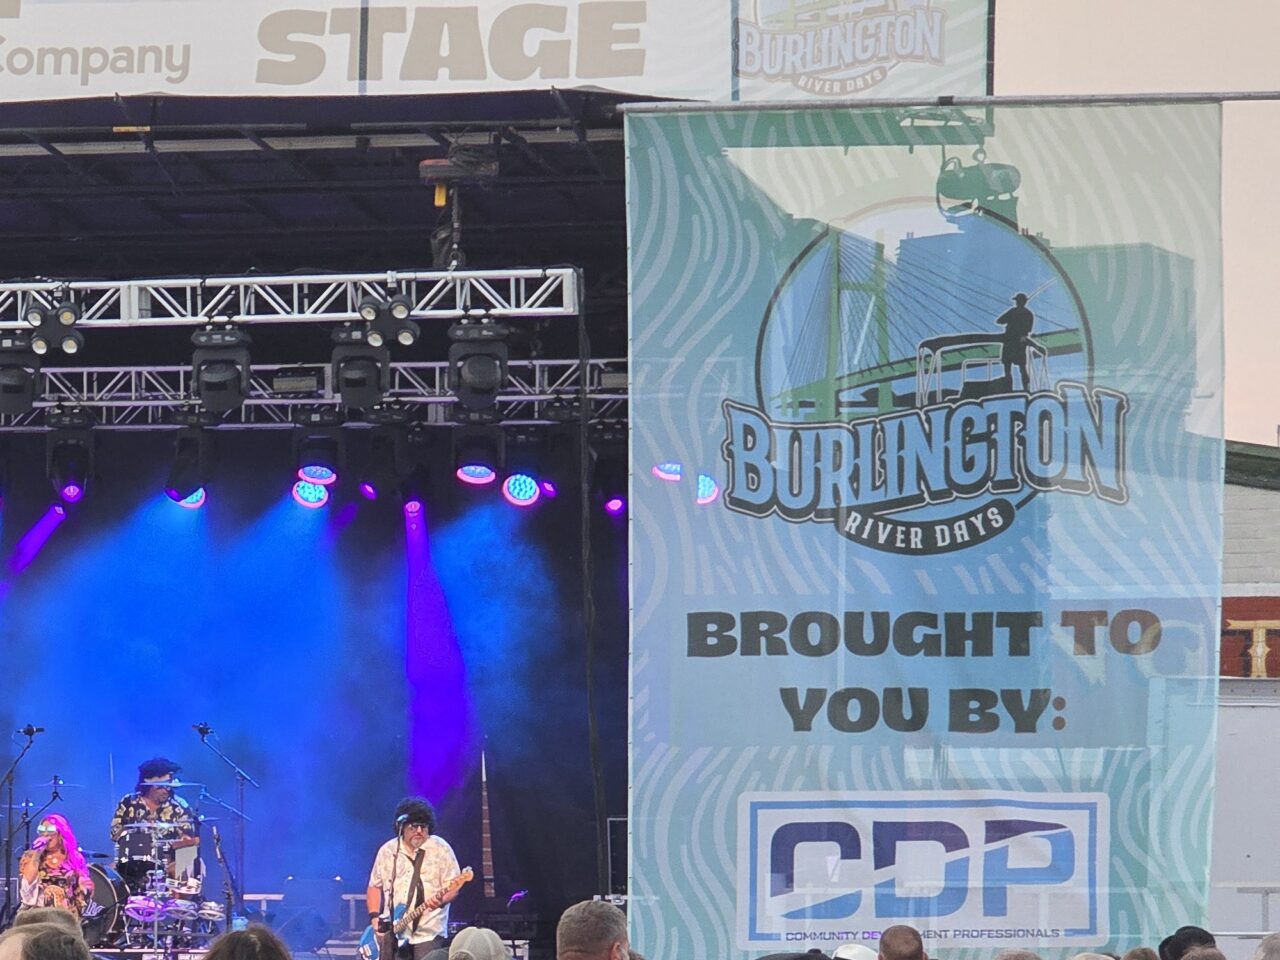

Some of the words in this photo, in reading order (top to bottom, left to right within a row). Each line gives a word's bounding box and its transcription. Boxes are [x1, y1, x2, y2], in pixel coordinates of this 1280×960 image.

[256, 0, 648, 85] STAGE
[734, 8, 946, 76] BURLINGTON
[798, 75, 840, 93] RIVER
[847, 70, 882, 92] DAYS
[726, 388, 1128, 508] BURLINGTON
[844, 510, 923, 548] RIVER
[934, 507, 1004, 547] DAYS
[686, 610, 1043, 658] BROUGHT
[1061, 609, 1162, 655] TO
[779, 687, 929, 733] YOU
[948, 688, 1068, 734] BY:
[770, 819, 1075, 919] CDP
[785, 930, 858, 942] COMMUNITY
[952, 928, 1060, 940] PROFESSIONALS
